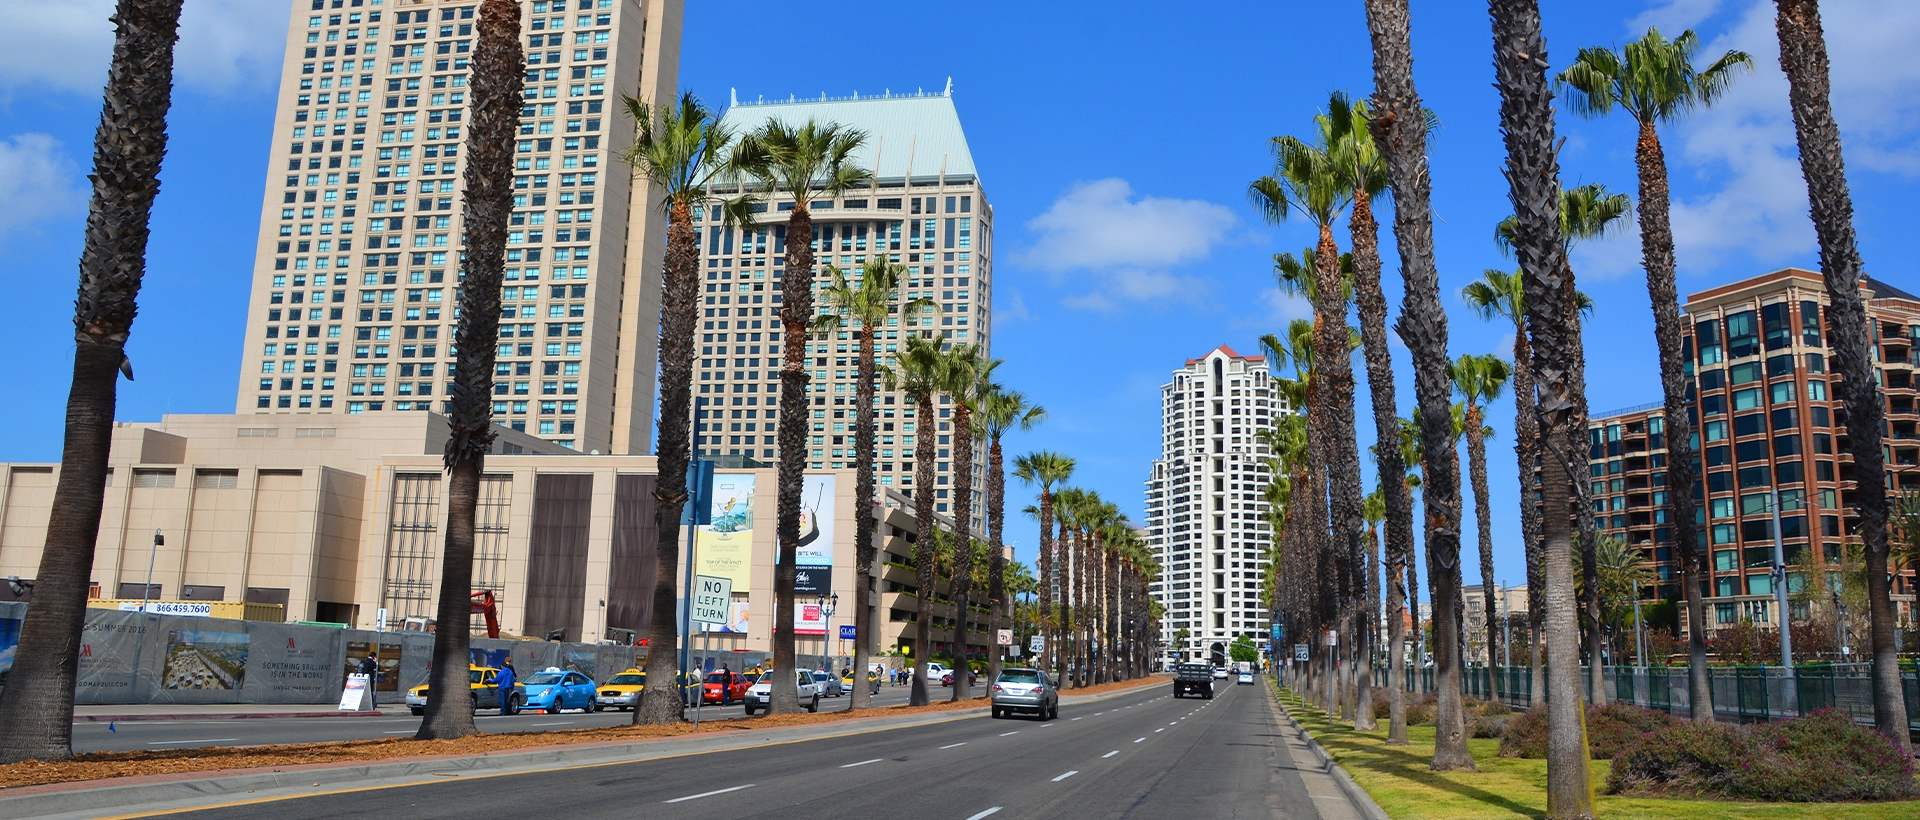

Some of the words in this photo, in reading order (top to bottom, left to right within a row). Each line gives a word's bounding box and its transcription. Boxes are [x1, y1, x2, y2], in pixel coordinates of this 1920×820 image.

[704, 581, 722, 593] NO
[698, 595, 724, 606] LEFT
[156, 604, 210, 613] 866.459.7600
[696, 607, 724, 619] TURN
[93, 623, 126, 633] SUMMER
[128, 626, 147, 634] 2016
[262, 661, 300, 670] SOMETHING
[288, 671, 300, 679] THE
